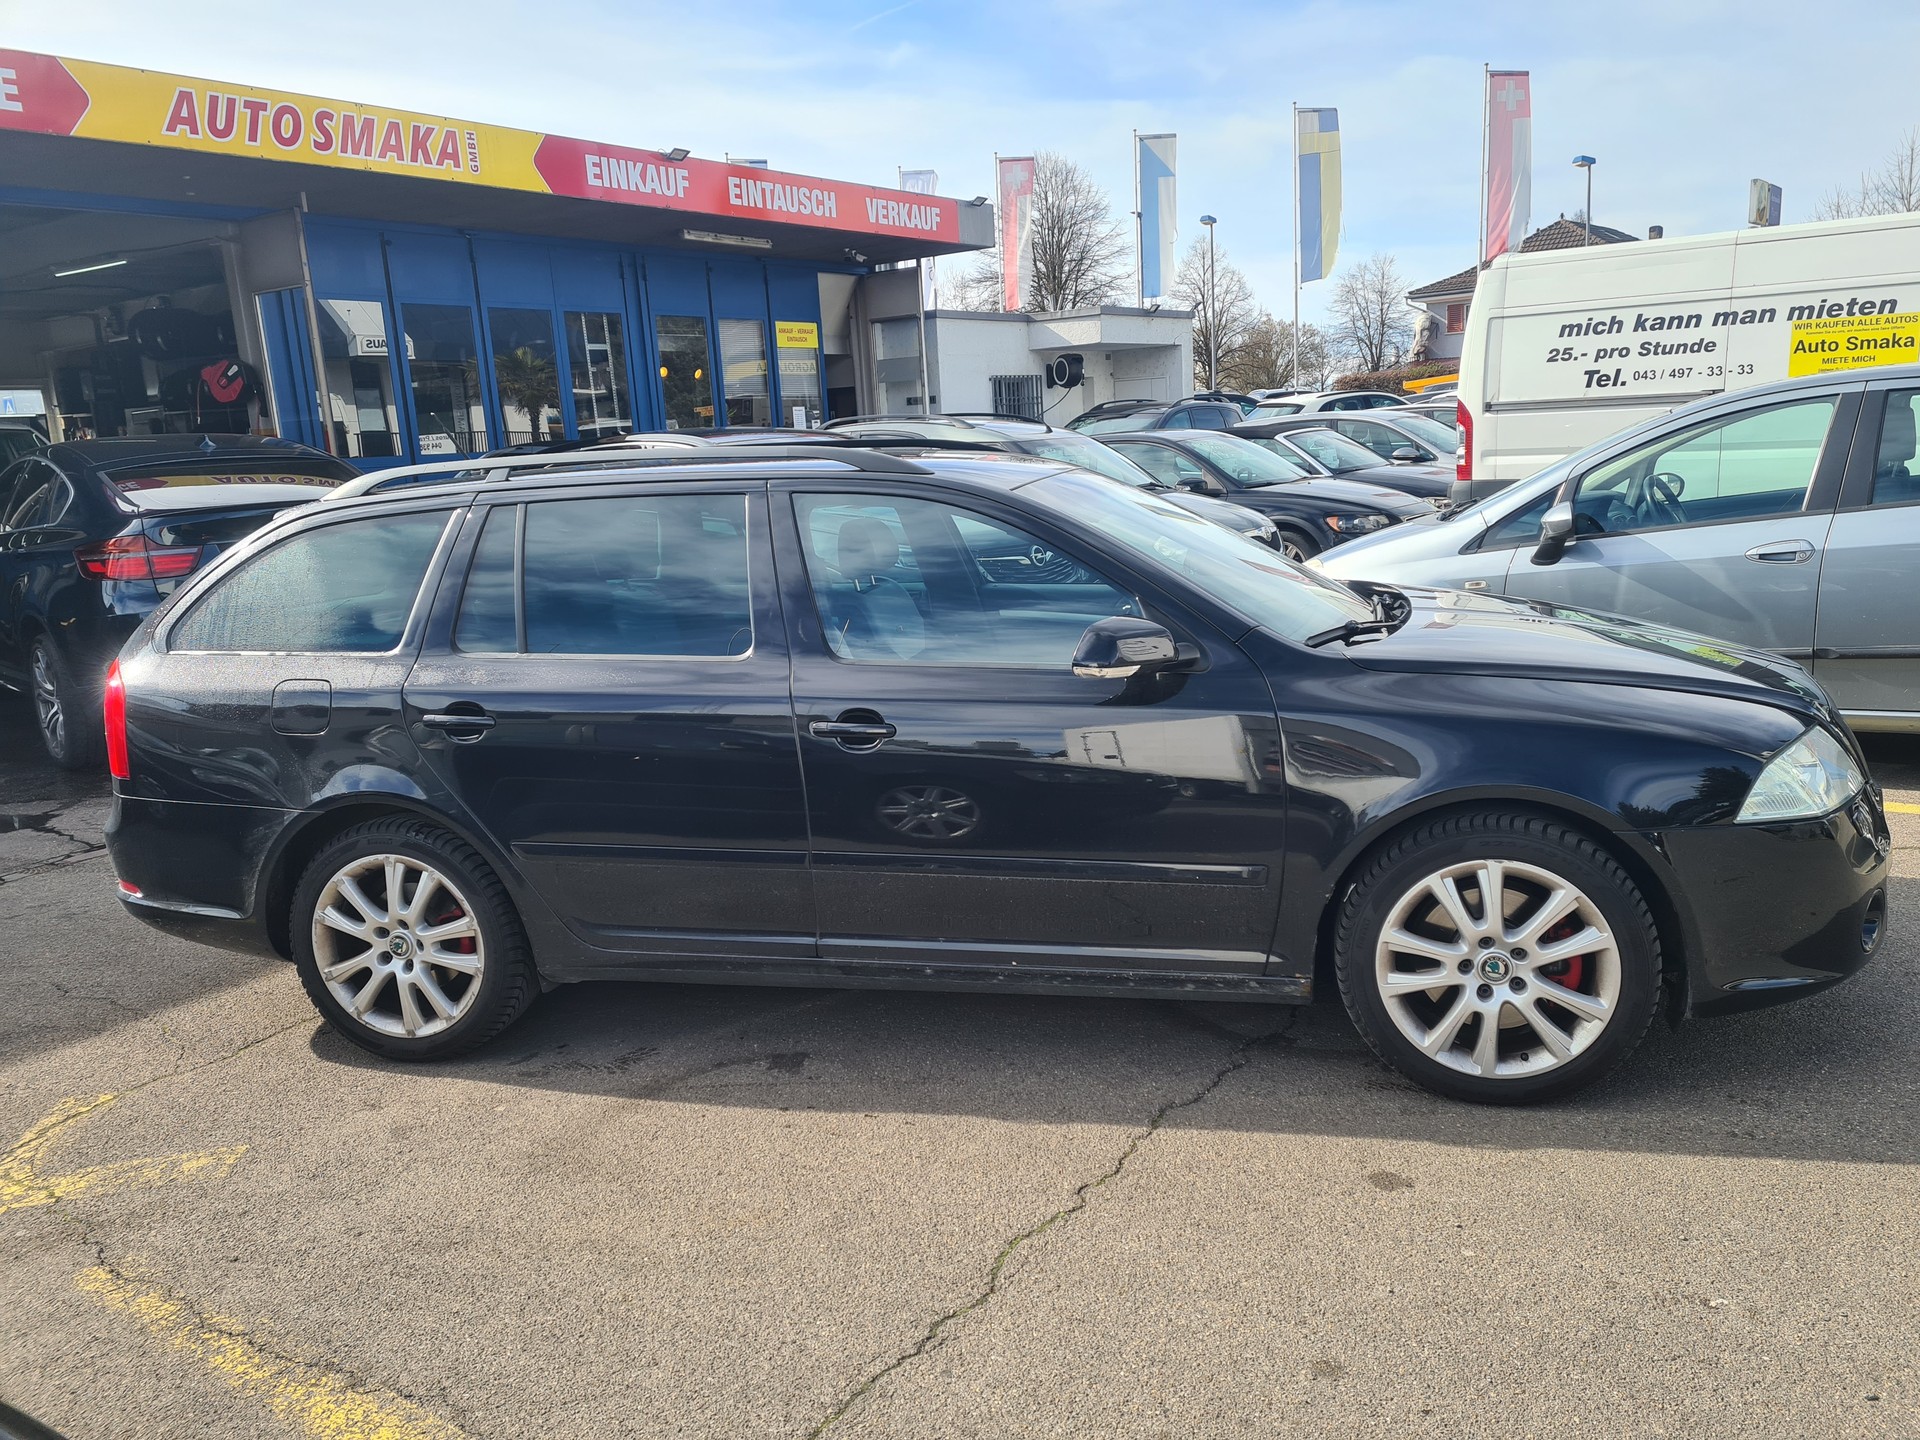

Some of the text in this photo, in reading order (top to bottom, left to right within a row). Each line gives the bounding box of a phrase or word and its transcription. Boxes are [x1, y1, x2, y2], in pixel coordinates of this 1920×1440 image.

[161, 87, 464, 170] AUTO SMAKA
[466, 131, 479, 173] GMBH
[585, 154, 689, 198] EINKAUF
[728, 176, 836, 218] EINTAUSCH
[866, 197, 941, 231] VERKAUF
[1559, 298, 1898, 338] mich kann man mieten
[1816, 320, 1854, 329] KAUFEN
[1858, 318, 1882, 326] ALLE
[1884, 315, 1918, 324] AUTOS
[1546, 338, 1716, 362] 25.- pro Stunde
[1793, 333, 1914, 354] Auto Smaka
[1822, 355, 1876, 365] MIETE MICH
[1584, 368, 1626, 388] Tel.
[1633, 370, 1656, 380] 043
[1660, 369, 1665, 379] /
[1669, 368, 1693, 378] 497
[1707, 366, 1723, 376] 33
[1737, 364, 1754, 374] 33
